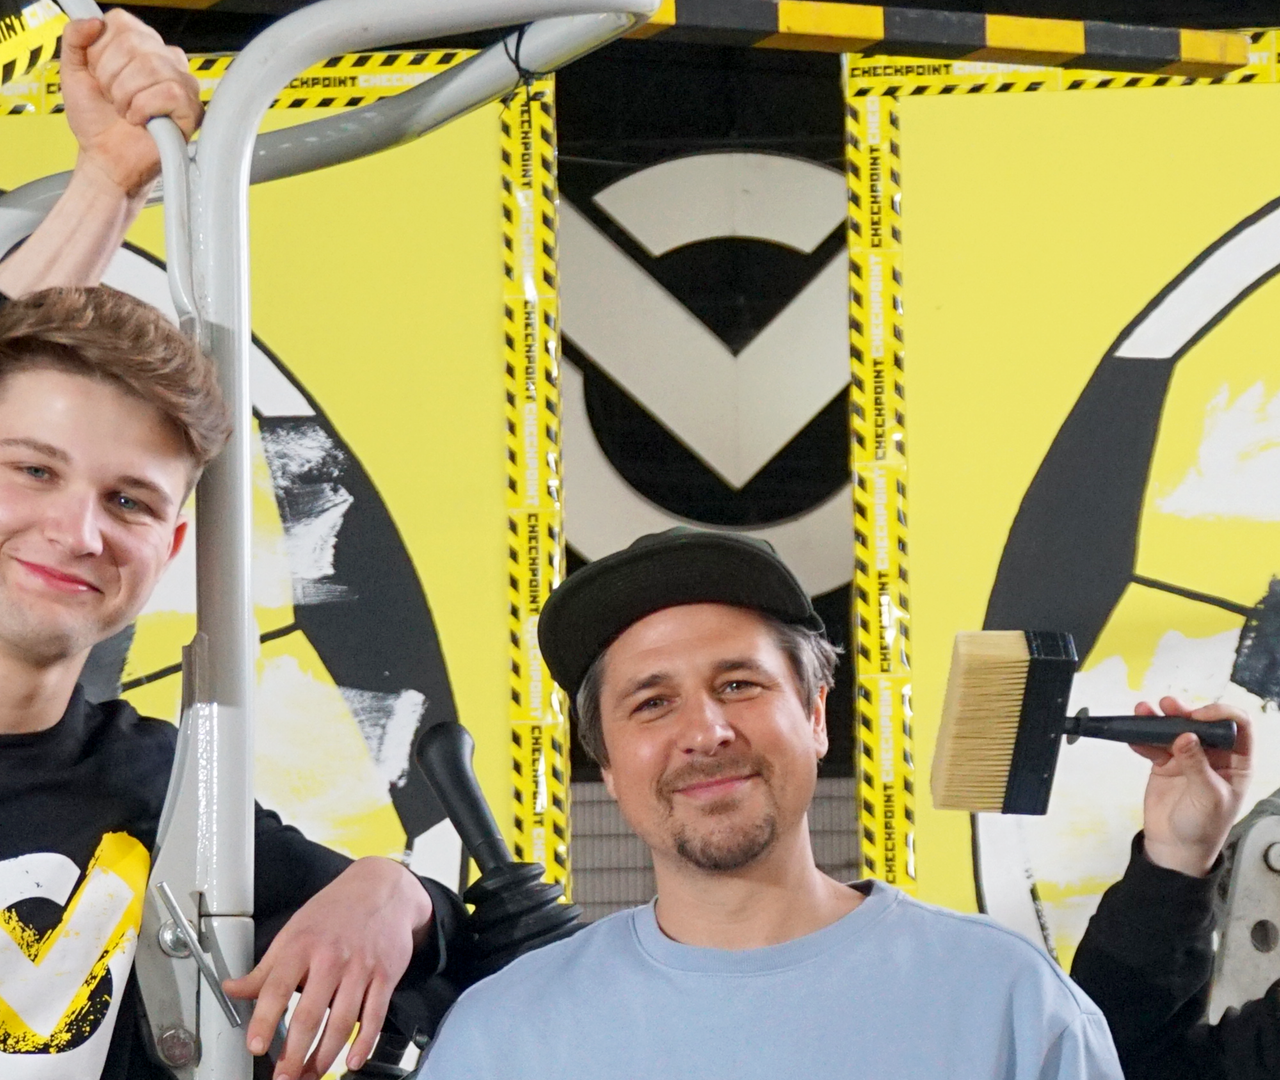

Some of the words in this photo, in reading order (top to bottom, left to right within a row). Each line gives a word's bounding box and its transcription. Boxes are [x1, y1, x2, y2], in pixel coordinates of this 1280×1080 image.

[284, 75, 358, 89] CKPOINT
[850, 63, 952, 78] CHECKPOINT
[870, 145, 884, 248] CHECKPOINT
[870, 253, 884, 357] CHECKPOINT
[524, 402, 540, 506] CHECKPOINT
[872, 358, 886, 461] CHECKPOINT
[527, 512, 541, 615] CHECKPOINT
[874, 467, 889, 570] CHECKPOINT
[879, 679, 894, 783] CHECKPOINT
[883, 783, 897, 884] CHECKPOINT
